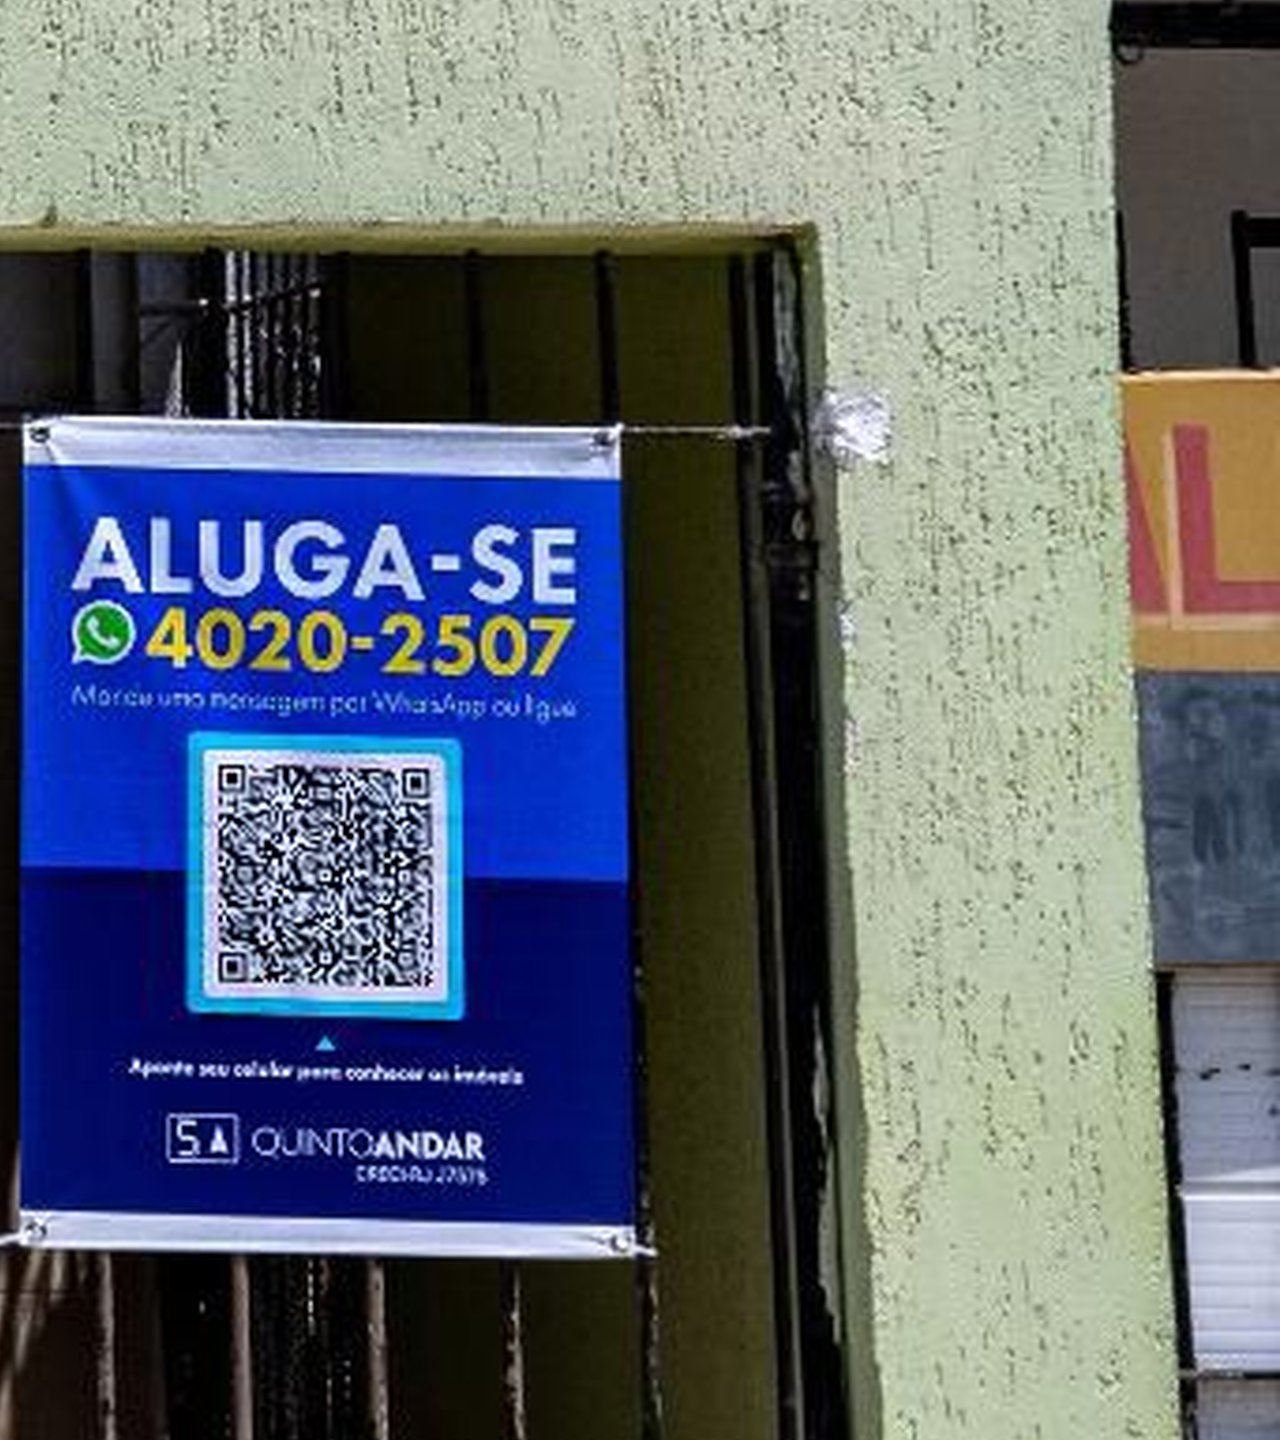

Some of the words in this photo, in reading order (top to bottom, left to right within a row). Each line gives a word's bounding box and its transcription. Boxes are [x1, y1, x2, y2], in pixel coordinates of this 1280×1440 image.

[71, 516, 578, 605] ALUGA-SE
[145, 608, 575, 678] 4020-2507
[251, 1125, 487, 1161] QUINTOANDAR
